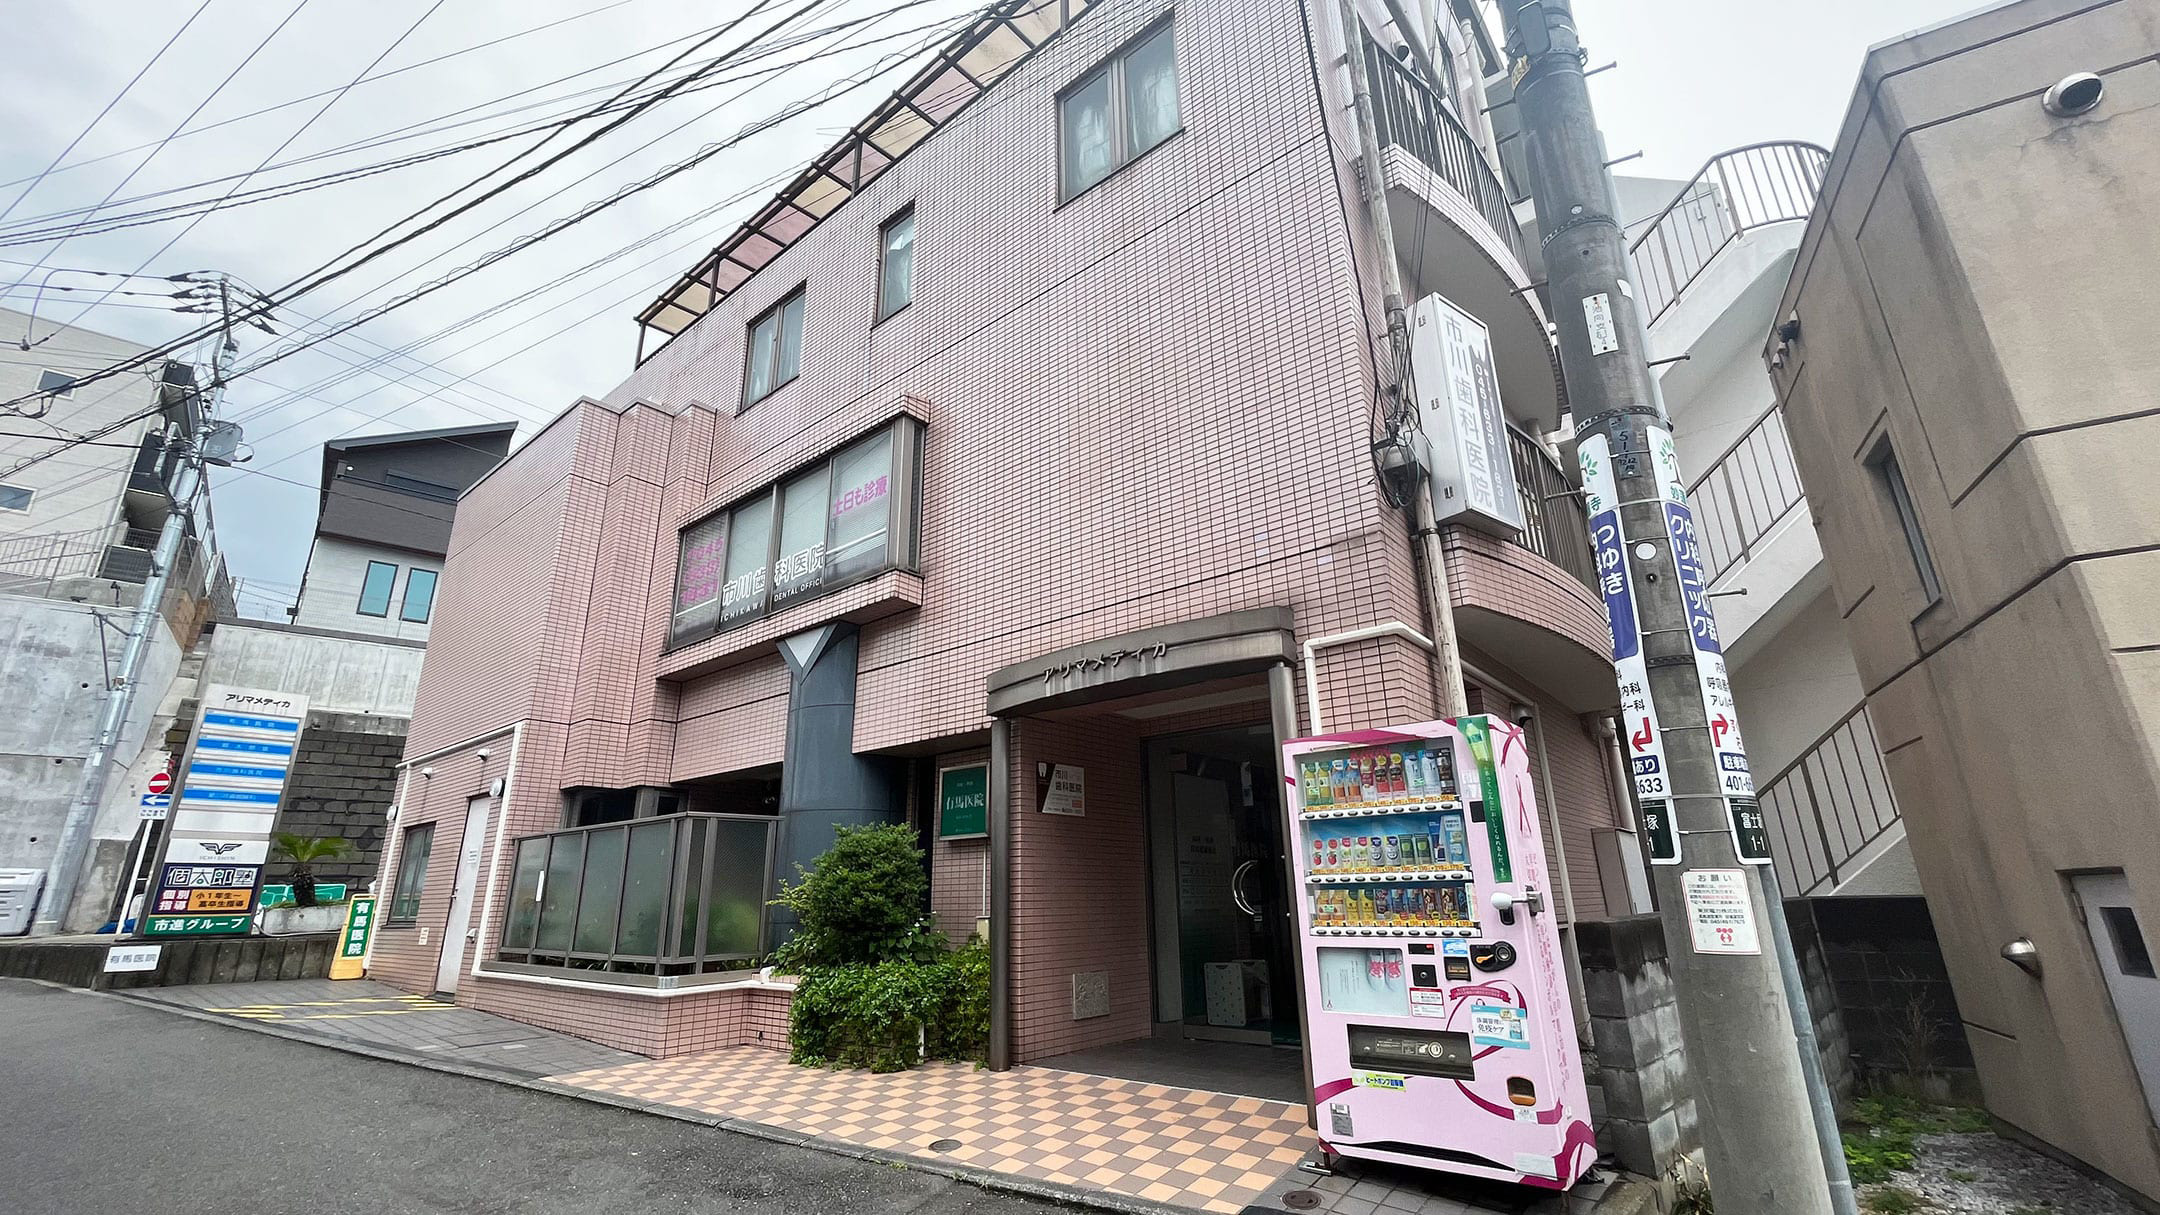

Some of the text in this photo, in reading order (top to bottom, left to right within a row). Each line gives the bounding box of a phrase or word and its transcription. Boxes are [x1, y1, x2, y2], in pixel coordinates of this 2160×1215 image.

[1443, 312, 1493, 508] 市川歯科医院
[832, 475, 888, 517] 土日も診療
[1598, 524, 1624, 596] つゆき
[722, 541, 825, 607] 市川歯科医院
[1670, 514, 1707, 637] クリニック
[774, 585, 799, 602] DENTAL
[1043, 640, 1168, 683] アリマメディカ
[225, 693, 291, 708] アリマメディカ
[946, 792, 985, 810] 有馬医院
[167, 867, 256, 886] 個太郎塾
[162, 889, 191, 899] 個別
[158, 900, 187, 911] 指導
[153, 916, 245, 932] 市進グループ
[347, 901, 371, 956] 有馬医院
[109, 953, 157, 965] 有馬医院
